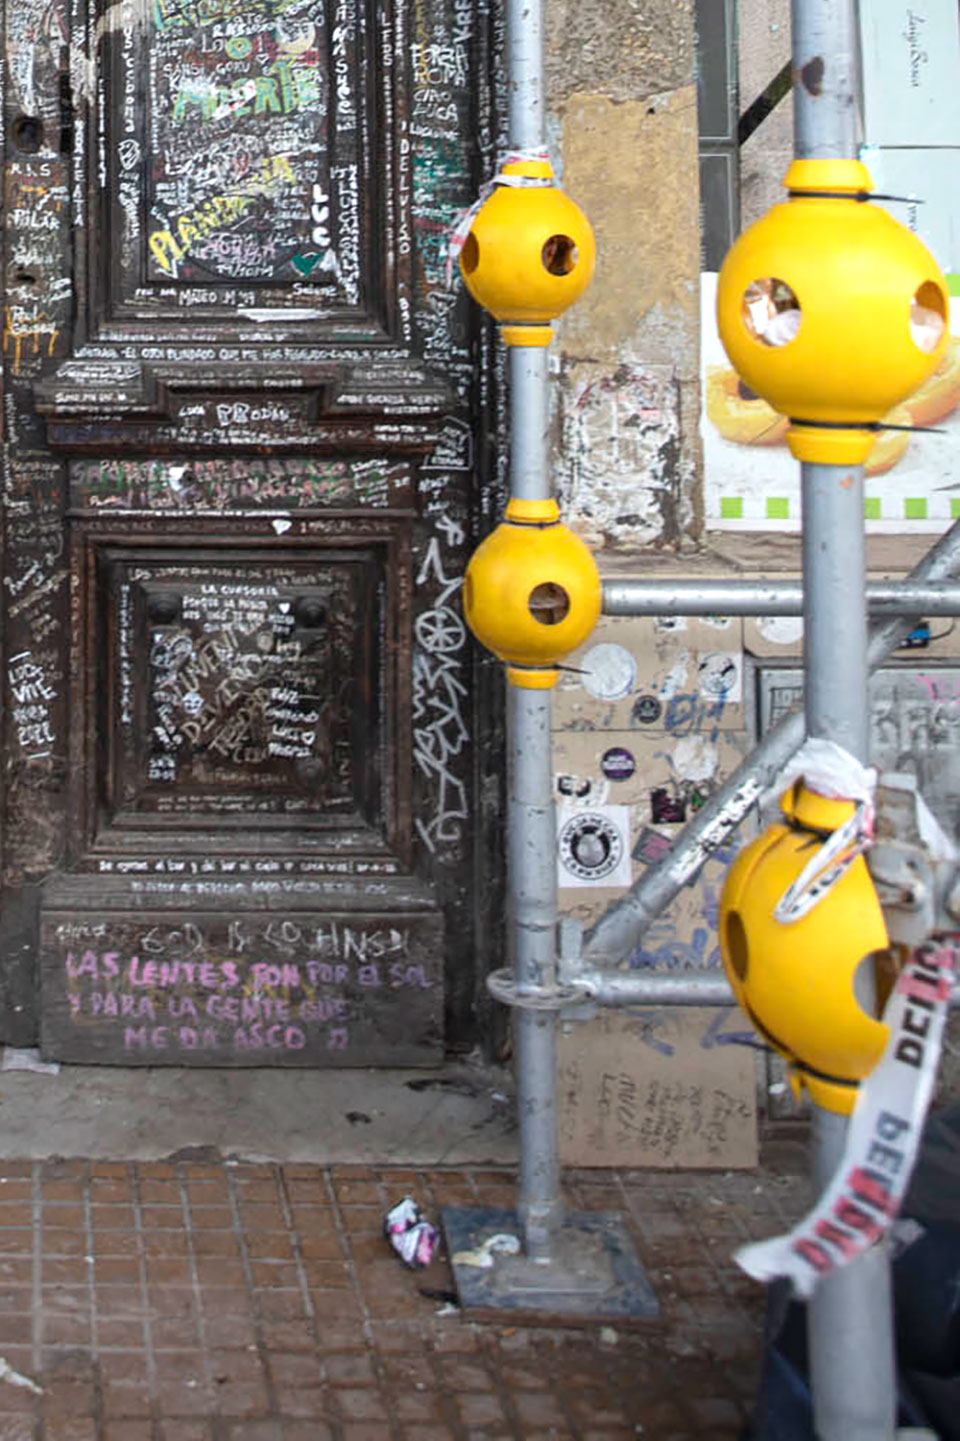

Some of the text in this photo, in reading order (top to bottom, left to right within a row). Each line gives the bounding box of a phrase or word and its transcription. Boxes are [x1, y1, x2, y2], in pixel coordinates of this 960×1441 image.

[66, 951, 121, 980] LAS
[129, 956, 240, 991] LENTES
[92, 994, 156, 1021] PARA
[169, 996, 199, 1018] LA
[206, 997, 290, 1021] GENTE
[124, 1027, 168, 1049] ME
[233, 1028, 307, 1050] ASCO
